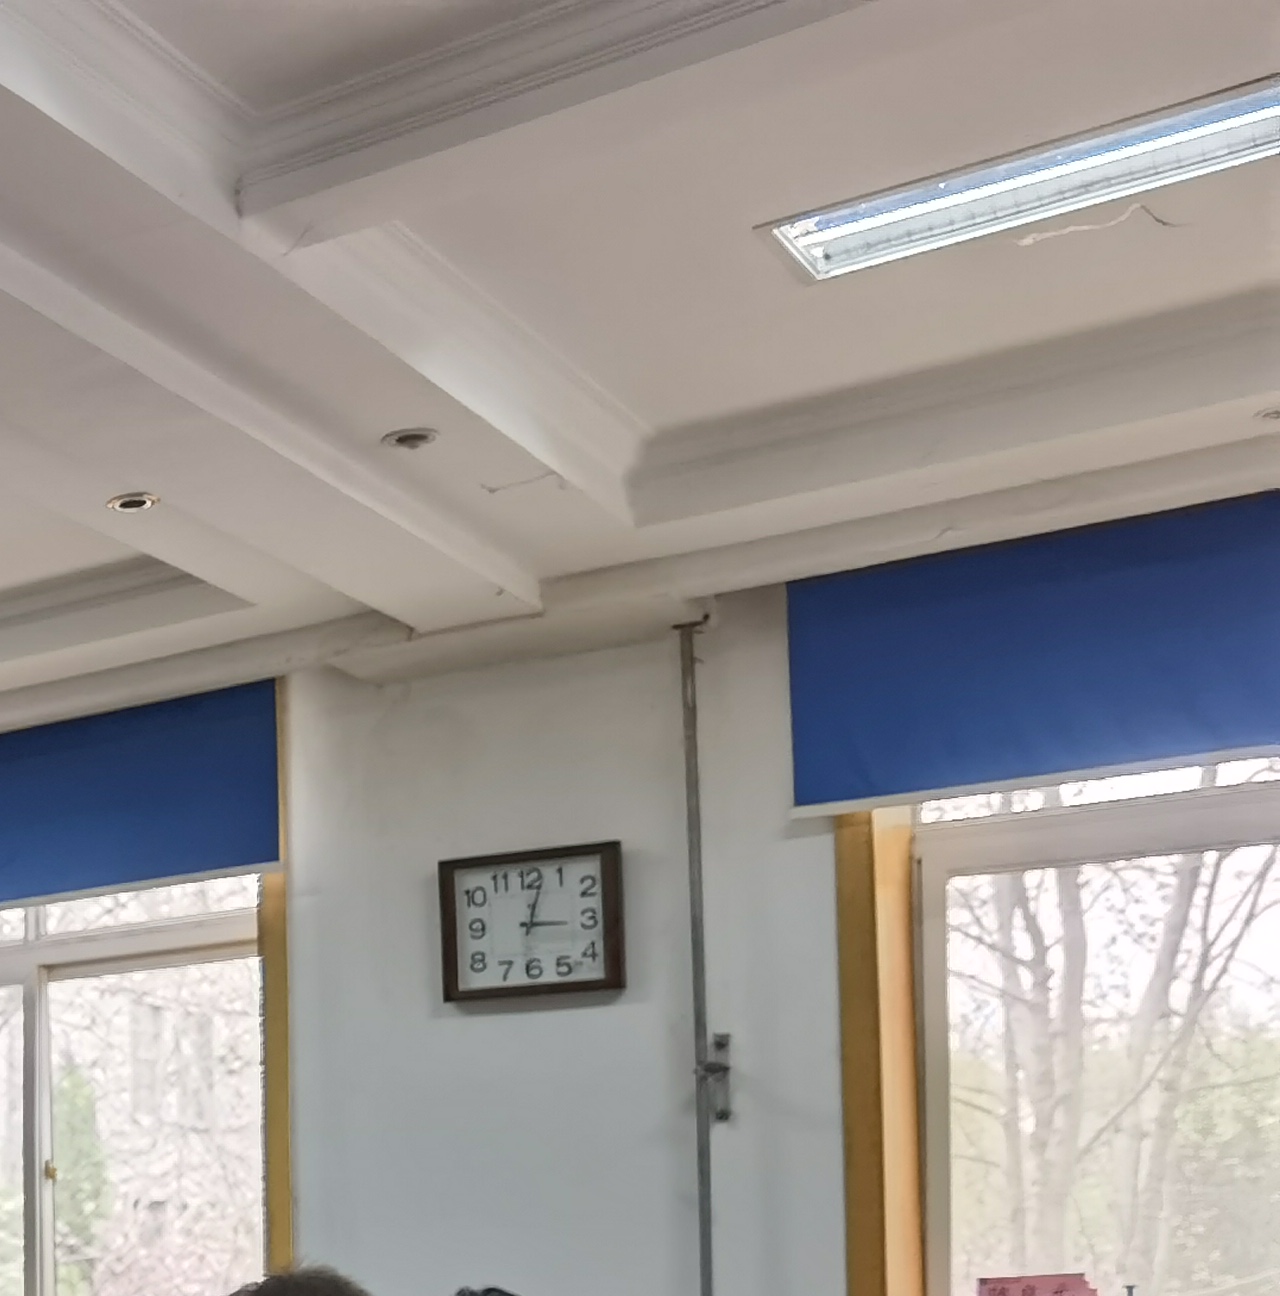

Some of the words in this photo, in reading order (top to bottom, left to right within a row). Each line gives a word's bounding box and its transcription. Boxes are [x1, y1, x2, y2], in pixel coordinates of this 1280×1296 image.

[464, 885, 487, 908] 10
[579, 875, 597, 898] 2
[491, 871, 509, 894] 11
[518, 867, 543, 891] 12
[555, 866, 564, 888] 1
[468, 918, 486, 940] 9
[580, 907, 598, 930] 3
[470, 951, 487, 973] 8
[581, 940, 599, 962] 4
[497, 959, 514, 982] 7
[525, 957, 543, 980] 6
[555, 955, 573, 977] 5
